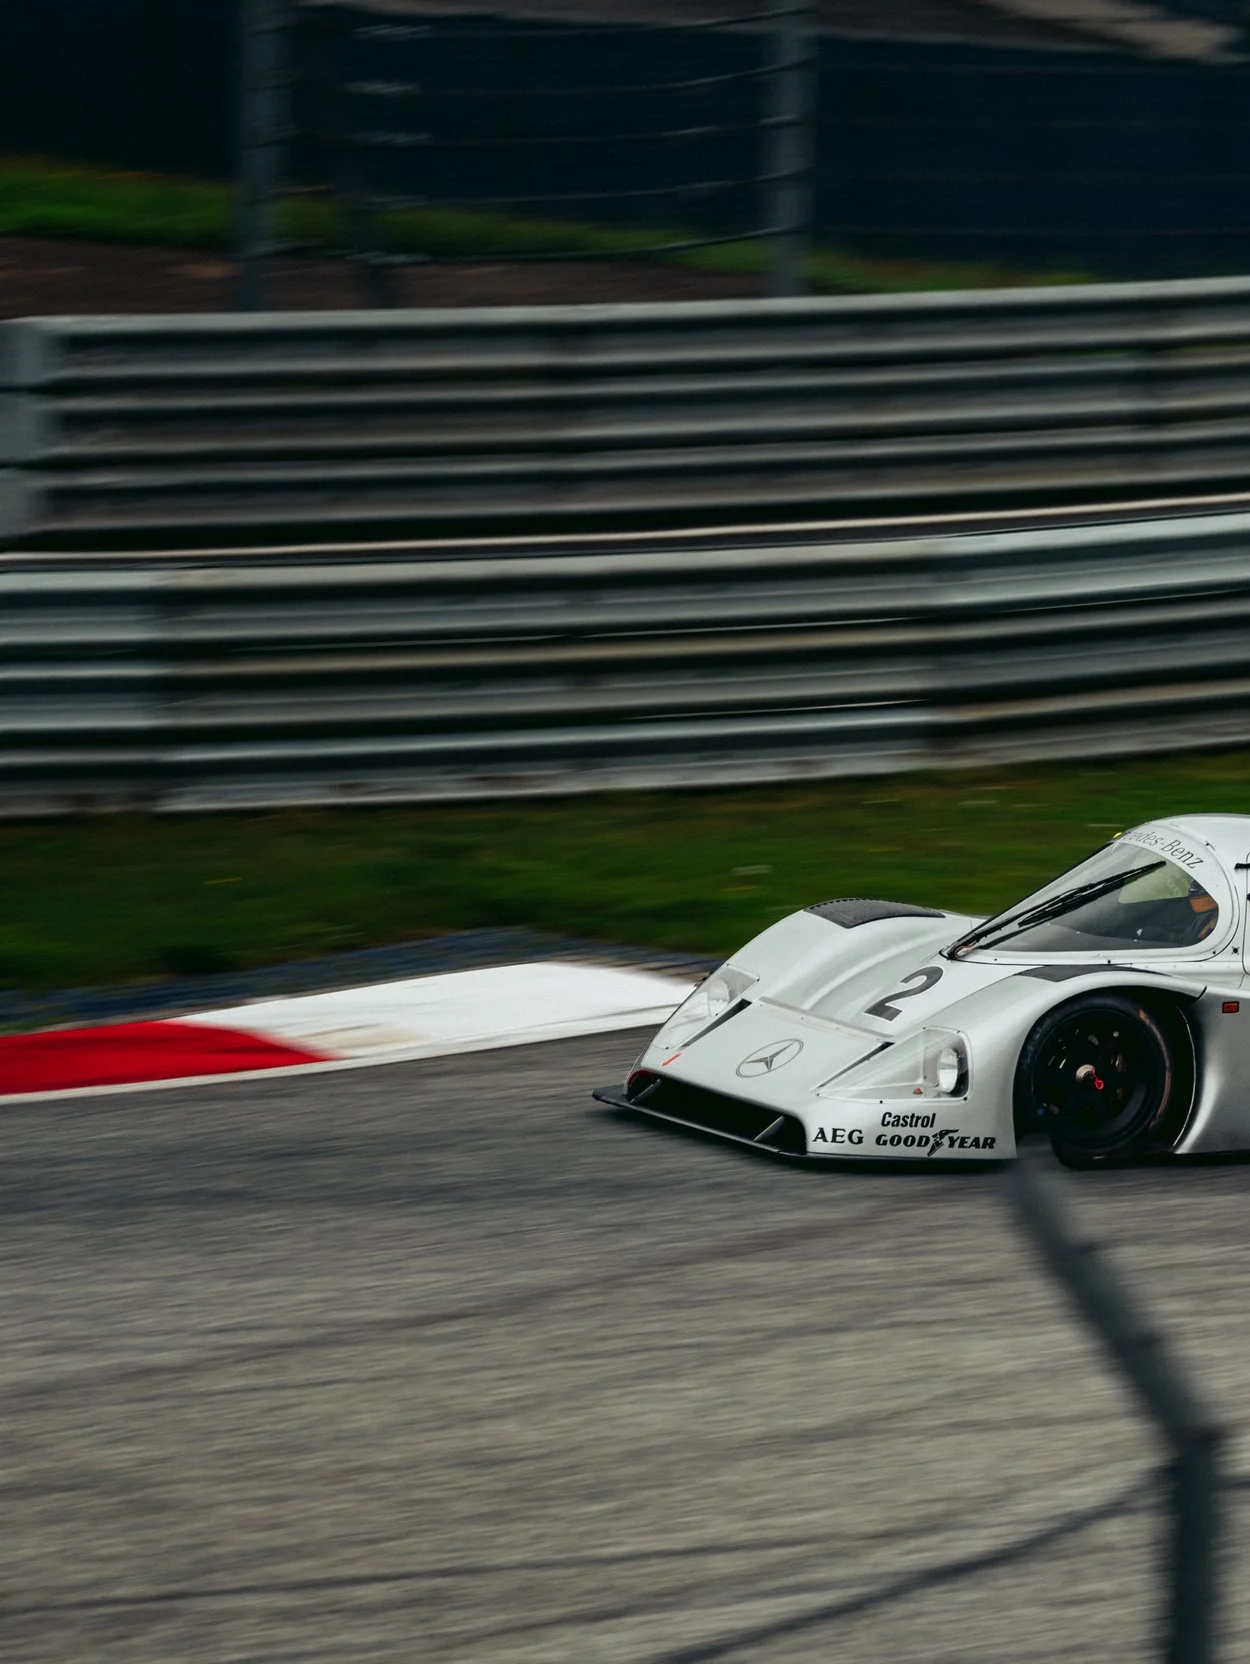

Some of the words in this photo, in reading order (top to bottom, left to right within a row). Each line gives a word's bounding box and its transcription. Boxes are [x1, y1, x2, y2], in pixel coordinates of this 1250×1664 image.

[863, 966, 944, 1022] 2
[881, 1112, 937, 1128] Castrol
[812, 1127, 864, 1145] AEG
[875, 1131, 996, 1150] GOODYEAR
